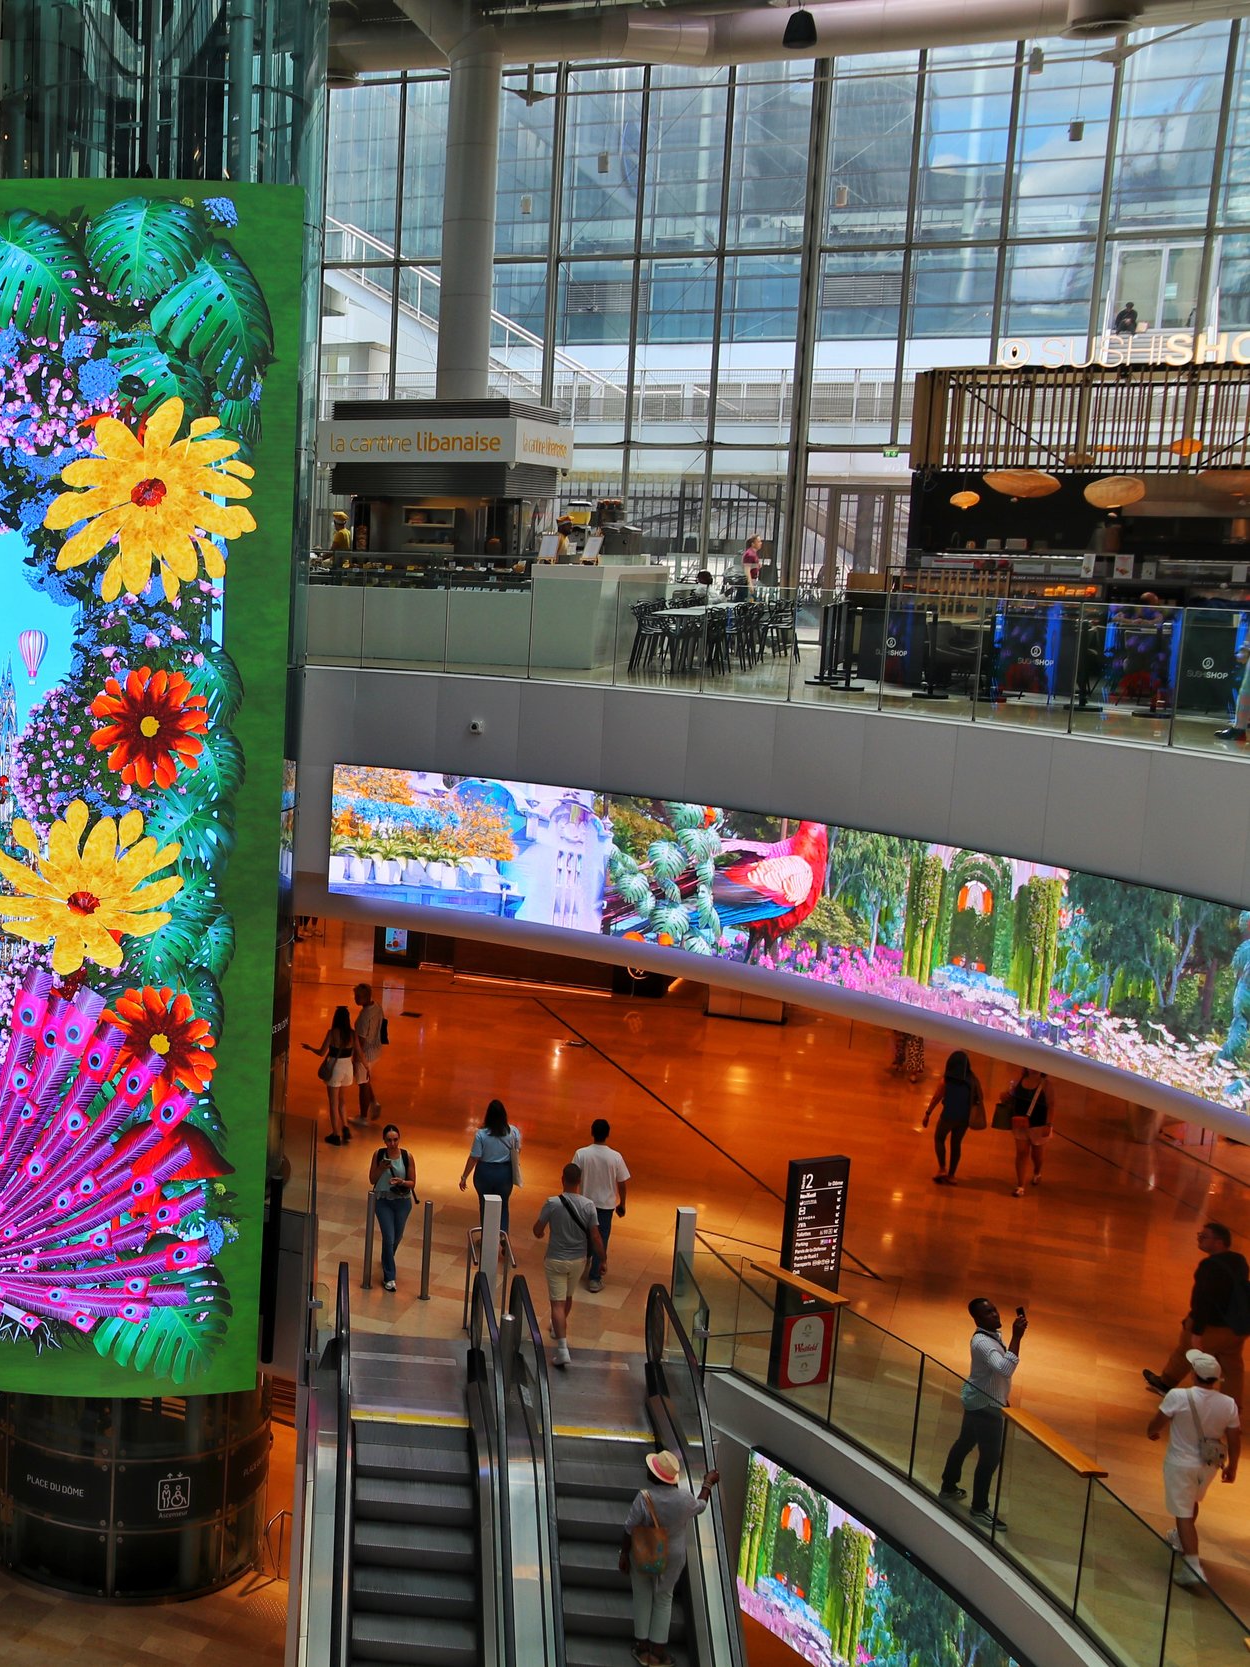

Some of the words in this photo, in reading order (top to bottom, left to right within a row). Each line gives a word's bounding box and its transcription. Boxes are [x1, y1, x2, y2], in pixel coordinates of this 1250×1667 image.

[330, 432, 345, 452] la
[350, 432, 412, 452] cantine
[416, 431, 501, 452] libanaise
[805, 1173, 814, 1189] 2
[26, 1473, 49, 1490] PLACE
[50, 1480, 61, 1493] DU
[61, 1482, 85, 1498] DÔME
[158, 1510, 189, 1519] Ascenseur
